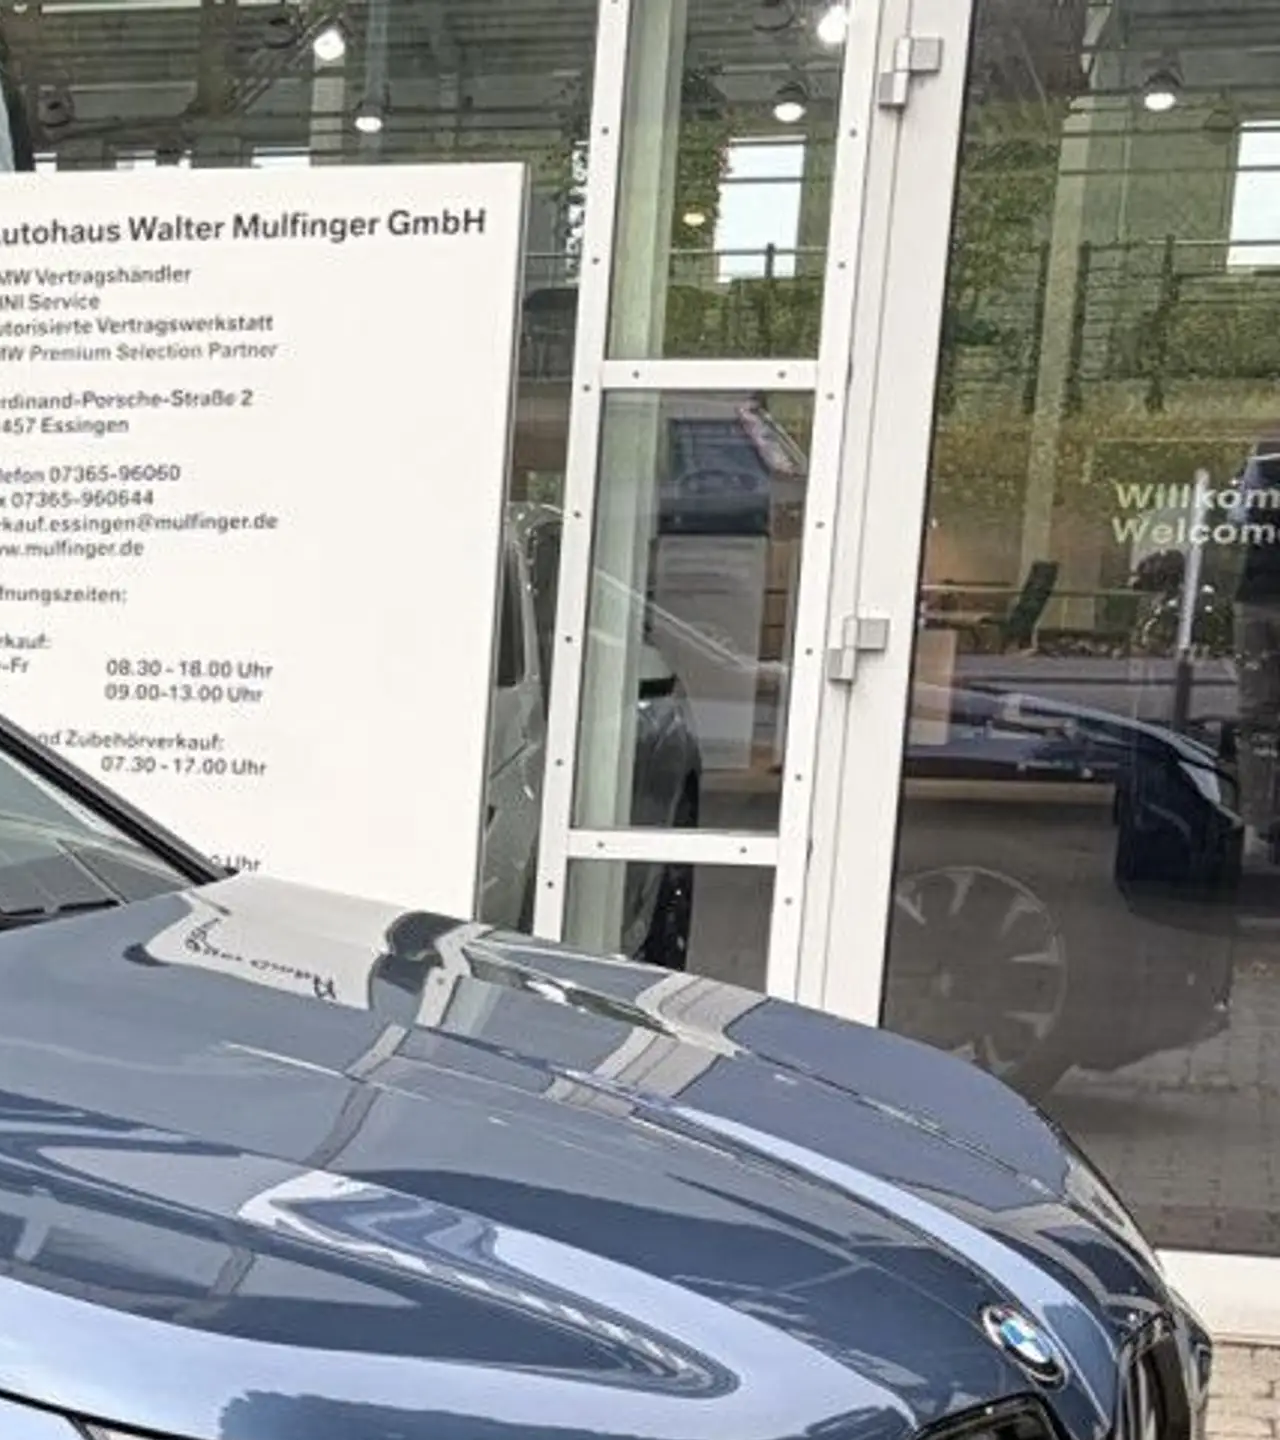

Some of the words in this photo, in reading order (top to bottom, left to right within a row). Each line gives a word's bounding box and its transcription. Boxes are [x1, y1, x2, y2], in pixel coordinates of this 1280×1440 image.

[128, 215, 225, 242] Walter
[233, 211, 380, 244] Mulfinger
[387, 207, 486, 236] GmbH
[35, 264, 192, 288] Vertragshändler
[28, 292, 101, 311] Service
[97, 315, 274, 337] Vertragswerkstatt
[29, 344, 111, 362] Premium
[116, 341, 202, 361] Selection
[208, 340, 278, 359] Partner
[240, 388, 254, 407] 2
[41, 416, 129, 438] Essingen
[1111, 516, 1280, 545] Welcom
[106, 659, 162, 678] 08.30
[179, 659, 233, 679] 18.00
[237, 661, 273, 680] Uhr
[227, 686, 264, 704] Uhr
[65, 730, 225, 752] Zubehörverkauf:
[101, 756, 156, 774] 07.30
[173, 757, 227, 776] 17.00
[231, 758, 267, 777] Uhr
